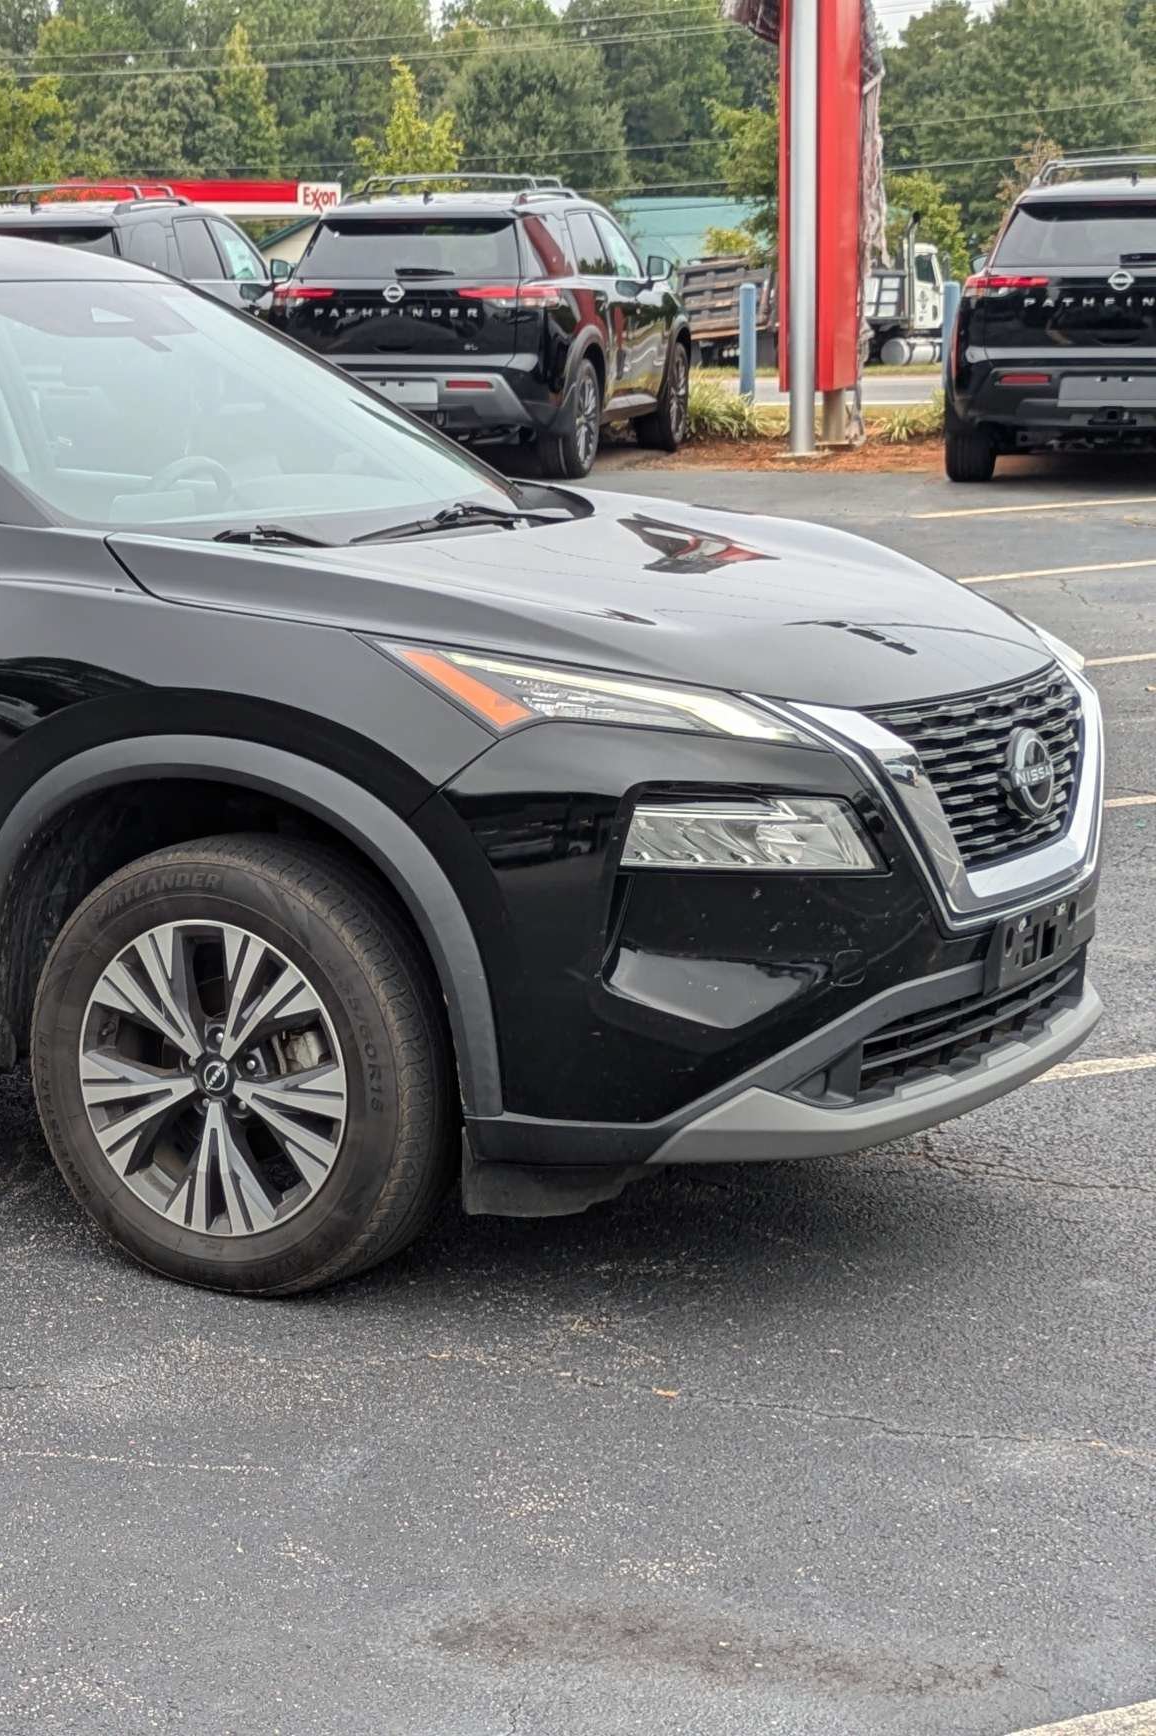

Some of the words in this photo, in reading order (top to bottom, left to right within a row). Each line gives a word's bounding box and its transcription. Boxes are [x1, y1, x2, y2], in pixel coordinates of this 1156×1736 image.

[303, 186, 337, 213] Exxon
[313, 308, 479, 318] PATHFINDER
[1015, 763, 1053, 785] NISSA
